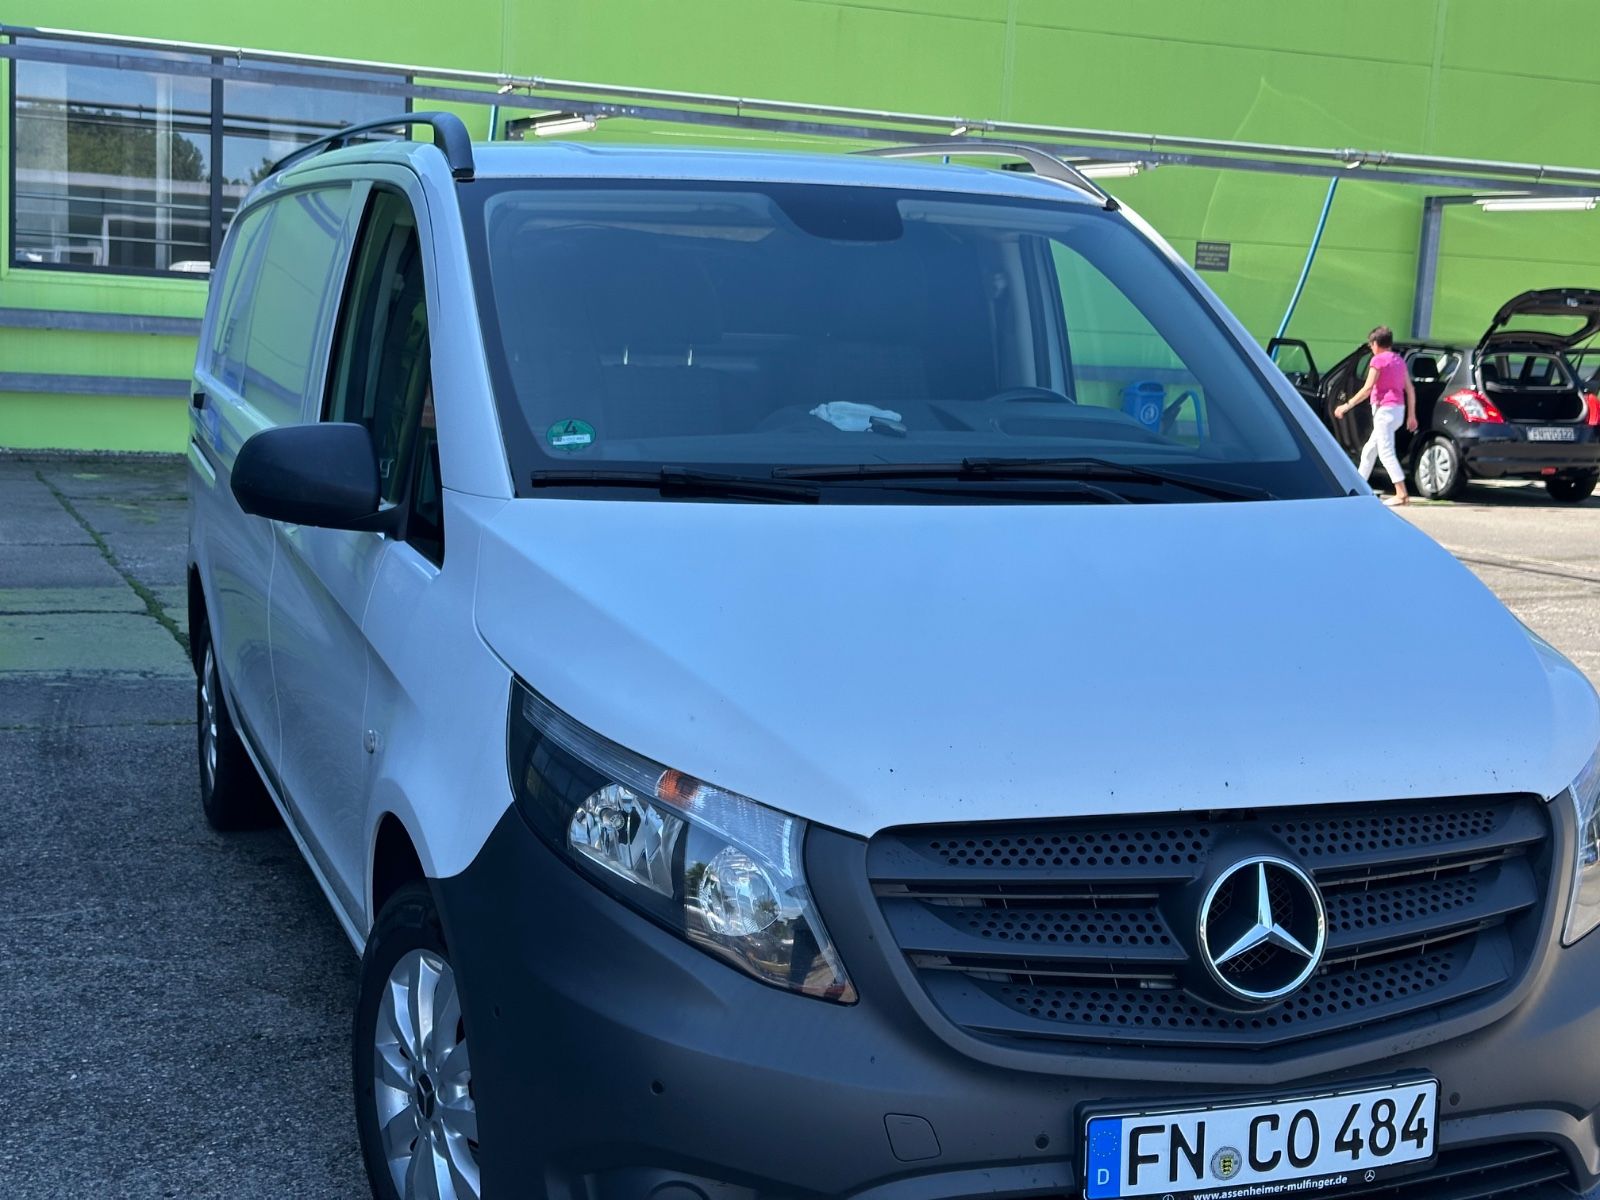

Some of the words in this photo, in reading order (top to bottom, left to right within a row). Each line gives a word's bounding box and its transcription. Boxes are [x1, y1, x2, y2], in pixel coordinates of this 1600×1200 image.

[564, 420, 577, 434] 4
[1128, 1121, 1206, 1186] FN
[1248, 1109, 1320, 1172] CO
[1334, 1093, 1428, 1160] 484
[1097, 1168, 1110, 1186] D
[1193, 1174, 1348, 1200] www.assenheimer-mulfinger.de
